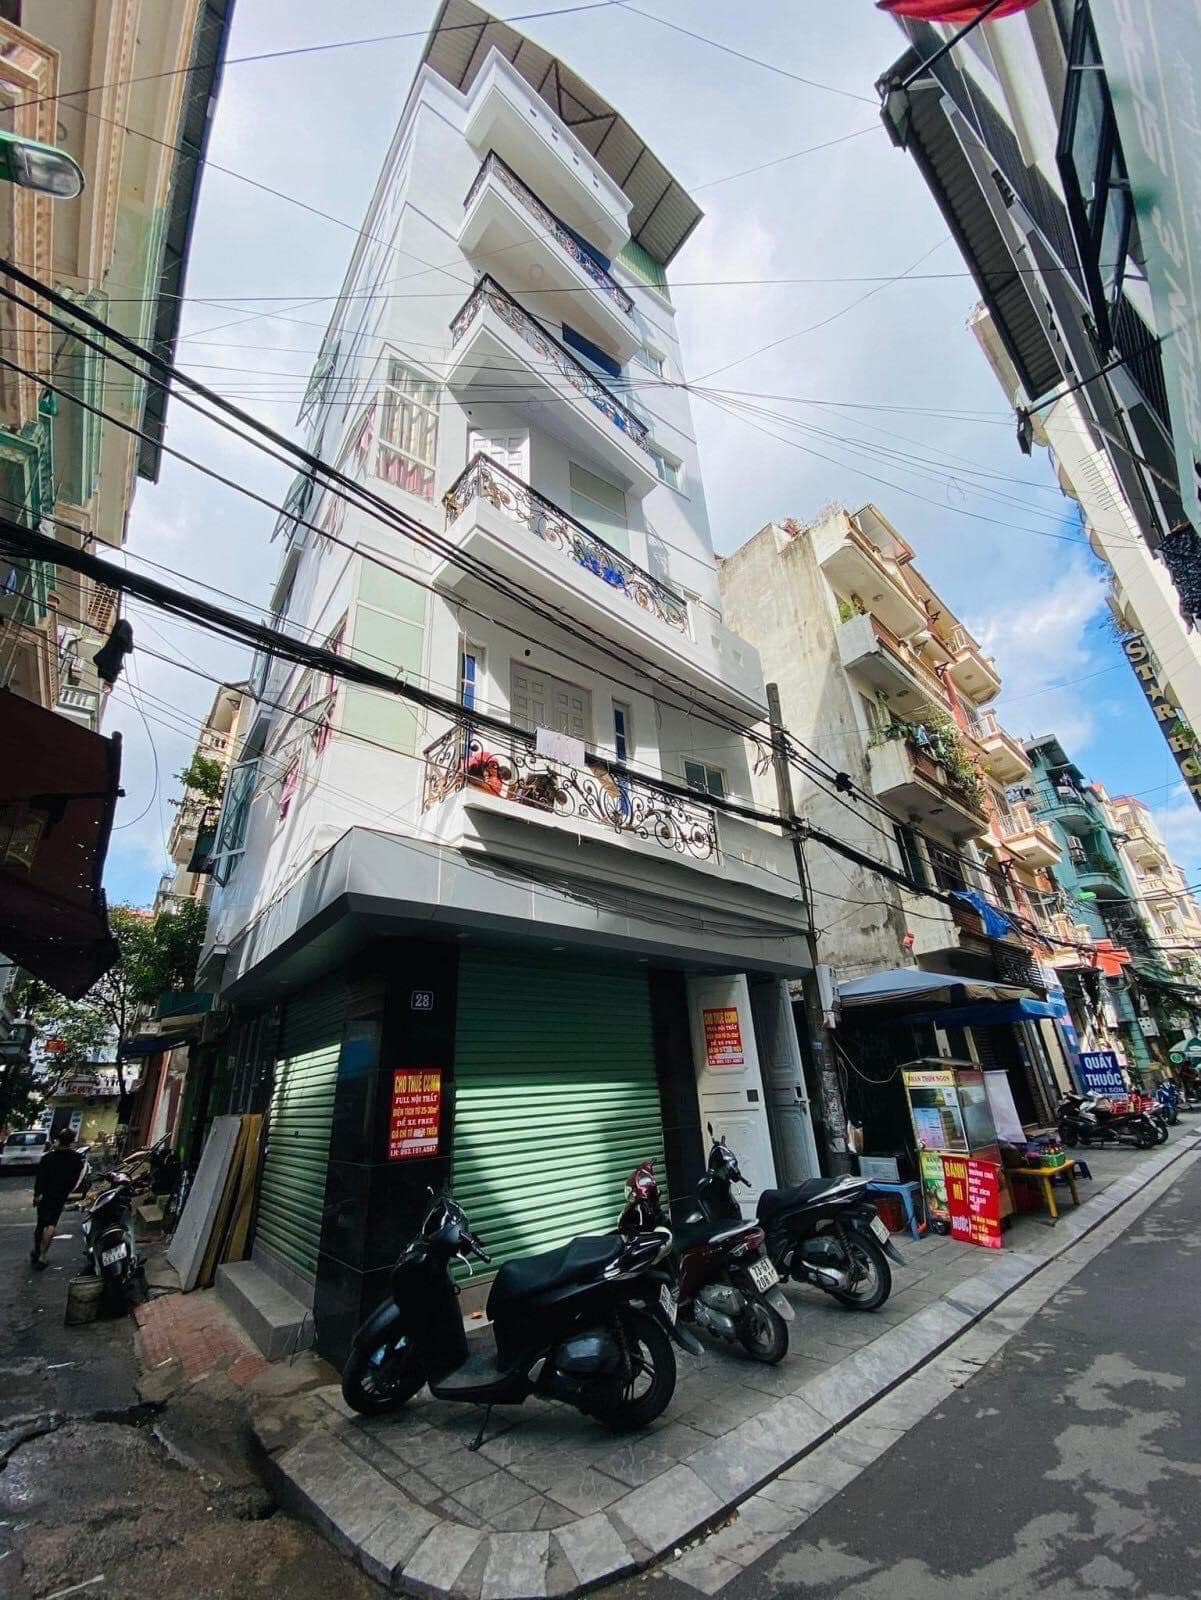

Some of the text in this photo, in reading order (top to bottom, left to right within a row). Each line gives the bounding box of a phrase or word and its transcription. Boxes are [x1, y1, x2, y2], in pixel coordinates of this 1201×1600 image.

[415, 994, 430, 1007] 28
[1086, 1069, 1122, 1086] THUỐC
[395, 1096, 410, 1105] FULL
[418, 1117, 434, 1125] FREE
[944, 1160, 966, 1180] BÁNH
